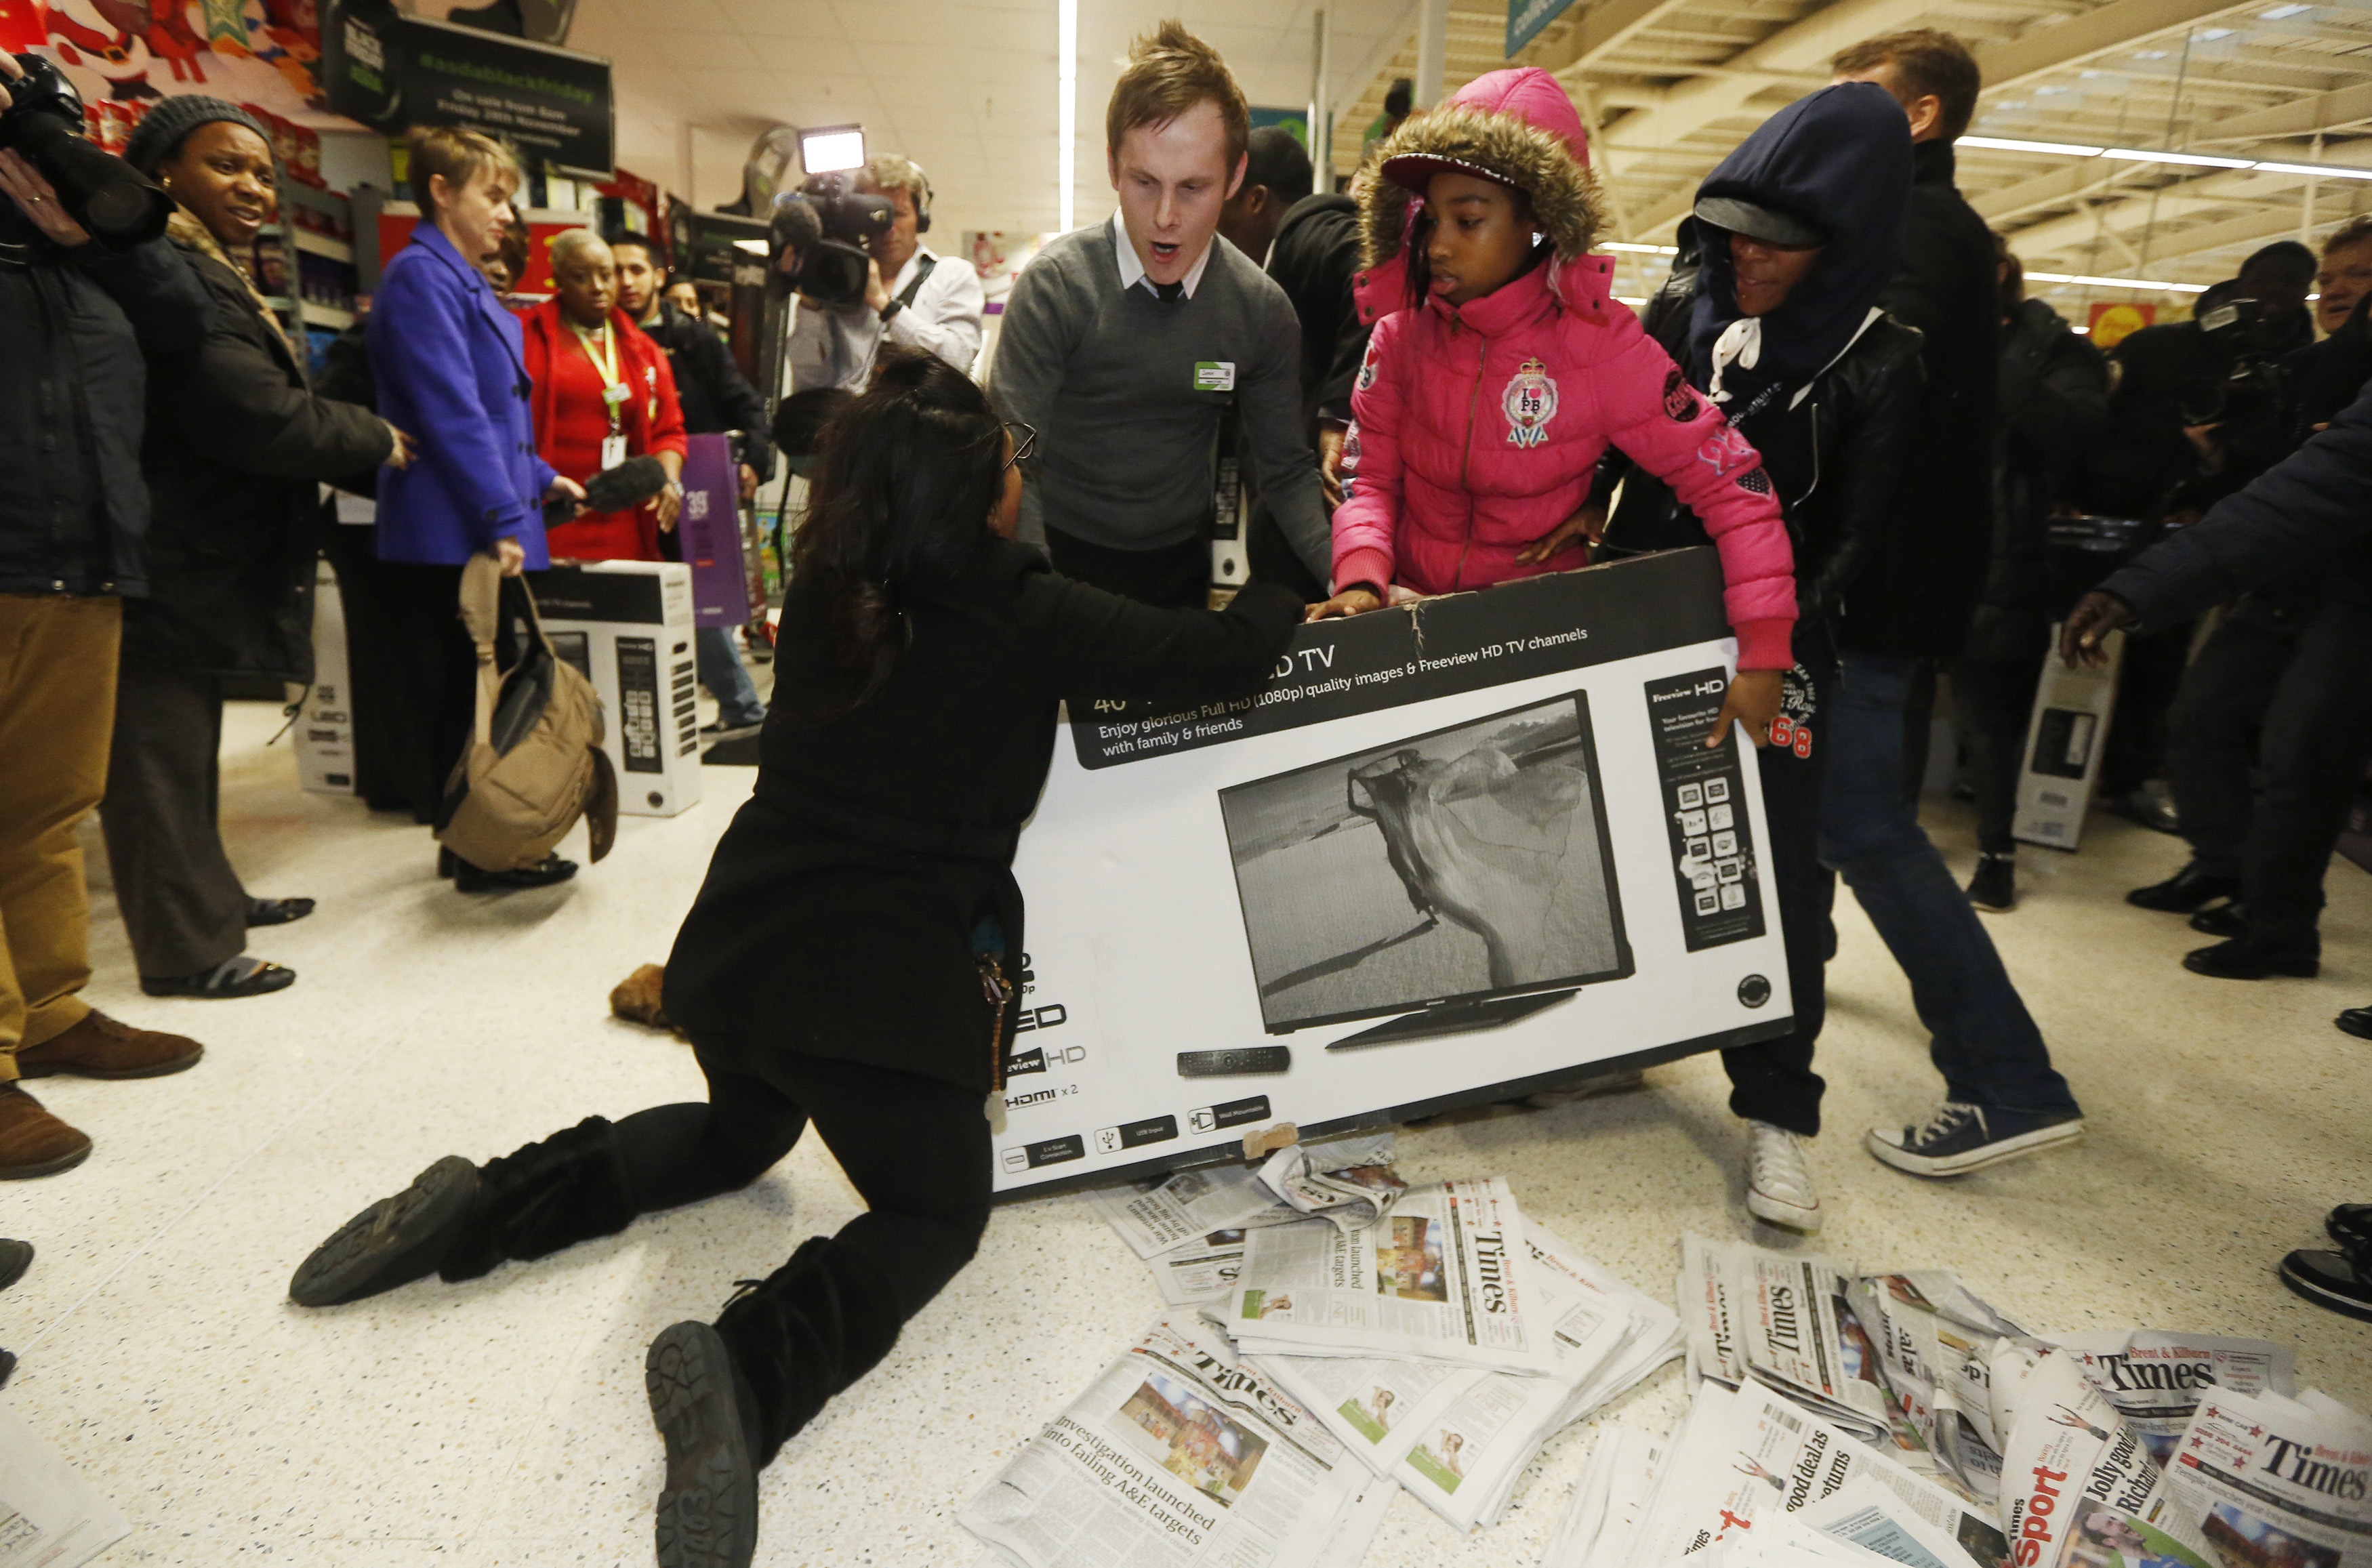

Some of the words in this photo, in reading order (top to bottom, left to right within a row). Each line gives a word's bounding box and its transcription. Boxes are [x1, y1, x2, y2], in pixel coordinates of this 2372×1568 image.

[1298, 644, 1335, 672] TV
[1099, 721, 1138, 739] Enjoy
[1141, 709, 1198, 731] glorious
[1200, 701, 1225, 718] Full
[1254, 685, 1305, 709] (1080p)
[1306, 677, 1352, 698] quality
[1355, 666, 1404, 686] images
[1406, 663, 1416, 675] &
[1419, 650, 1479, 673] Freeview
[1481, 644, 1502, 659] HD
[1506, 639, 1525, 654] TV
[1528, 627, 1588, 651] channels
[1652, 688, 1692, 703] Freeview
[1695, 679, 1725, 697] HD
[1103, 738, 1134, 757] with
[1137, 730, 1179, 750] family
[1183, 727, 1192, 740] &
[1195, 718, 1243, 738] friends
[1046, 1046, 1086, 1069] HD
[1005, 1088, 1056, 1108] HDMI
[1071, 1084, 1079, 1095] 2
[1332, 1255, 1345, 1288] targets
[1351, 1246, 1364, 1289] launched
[1475, 1231, 1507, 1313] Times
[1765, 1286, 1801, 1355] Times
[2098, 1353, 2217, 1391] Times
[2129, 1346, 2161, 1359] Brent
[2161, 1346, 2171, 1359] &
[2171, 1346, 2211, 1359] Kilburn
[1193, 1350, 1297, 1426] Times
[1055, 1416, 1144, 1483] Investigation
[1143, 1476, 1216, 1531] launched
[1797, 1444, 1823, 1479] deal
[1812, 1430, 1828, 1450] as
[2260, 1433, 2369, 1502] Times
[1043, 1428, 1071, 1447] into
[1070, 1443, 1116, 1486] failing
[1114, 1479, 1151, 1508] A&E
[1149, 1503, 1202, 1546] targets
[2086, 1464, 2126, 1502] Jolly
[2116, 1460, 2159, 1516] Richard
[2016, 1465, 2068, 1567] sport
